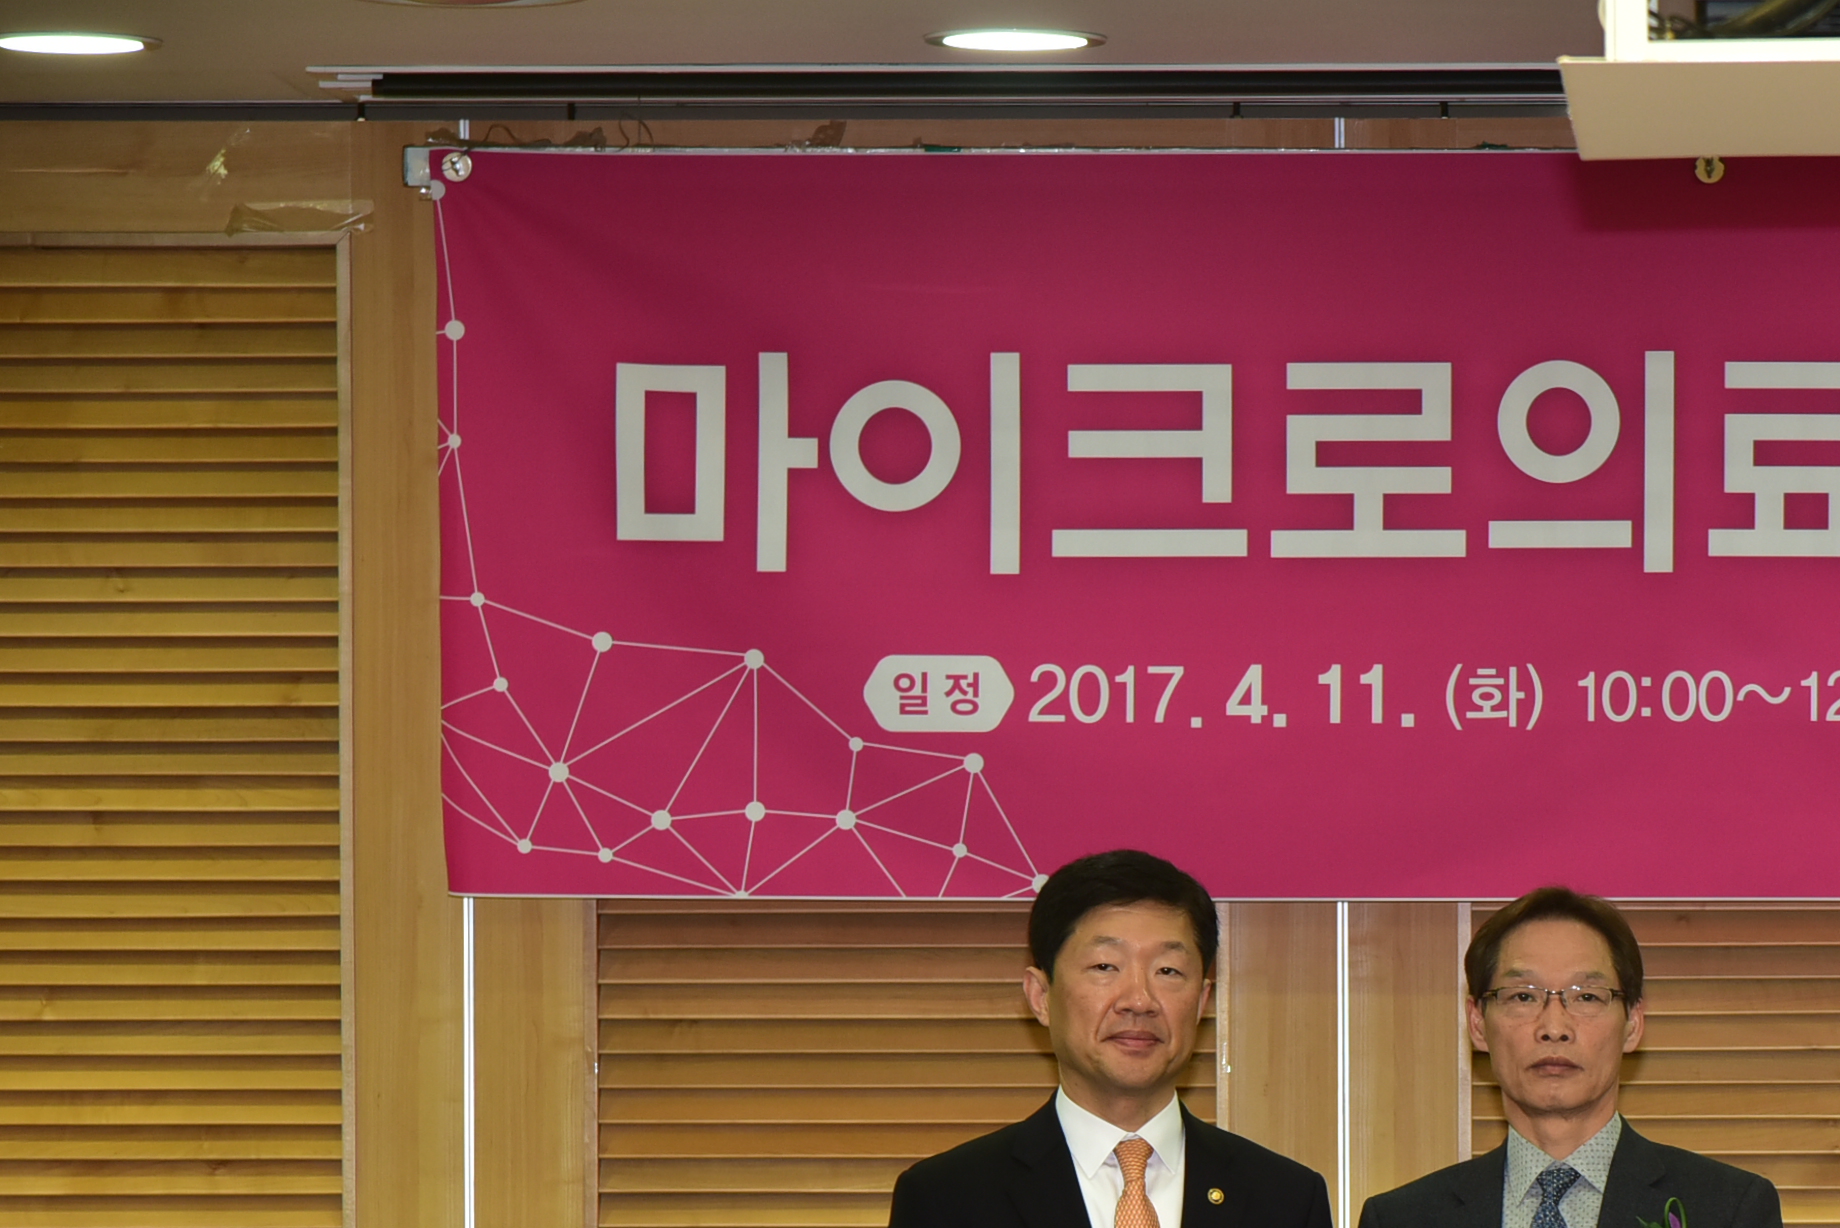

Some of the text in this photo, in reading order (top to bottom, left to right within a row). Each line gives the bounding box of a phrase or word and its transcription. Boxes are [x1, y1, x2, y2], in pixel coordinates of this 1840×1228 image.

[1027, 663, 1203, 729] 2017.
[1225, 664, 1287, 728] 4.
[1318, 663, 1415, 728] 11.
[1445, 663, 1543, 731] (화)
